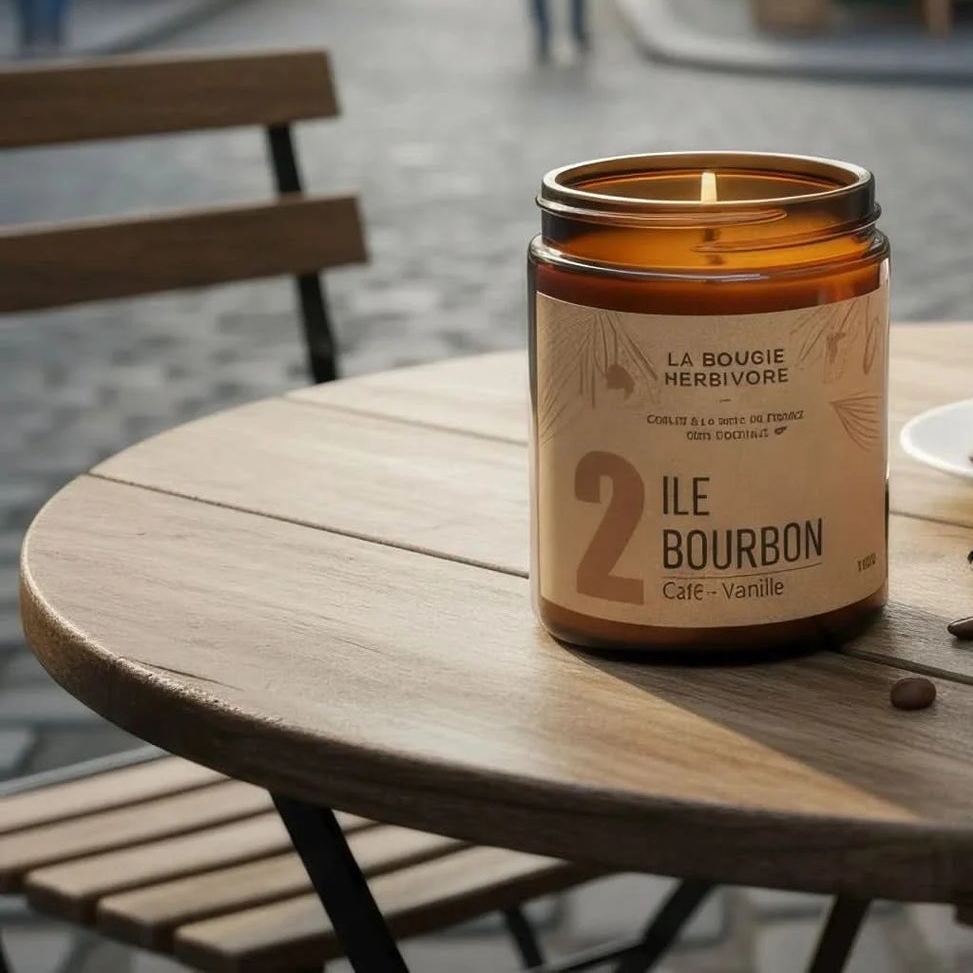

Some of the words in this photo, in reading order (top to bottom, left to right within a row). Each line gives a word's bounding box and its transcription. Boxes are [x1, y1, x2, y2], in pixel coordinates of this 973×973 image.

[668, 352, 693, 367] LA
[702, 349, 784, 367] BOUGIE
[664, 368, 789, 387] HERBIVORE
[662, 476, 710, 517] ILE
[574, 450, 645, 605] 2
[662, 518, 823, 571] BOURBON
[721, 577, 785, 600] Vanille
